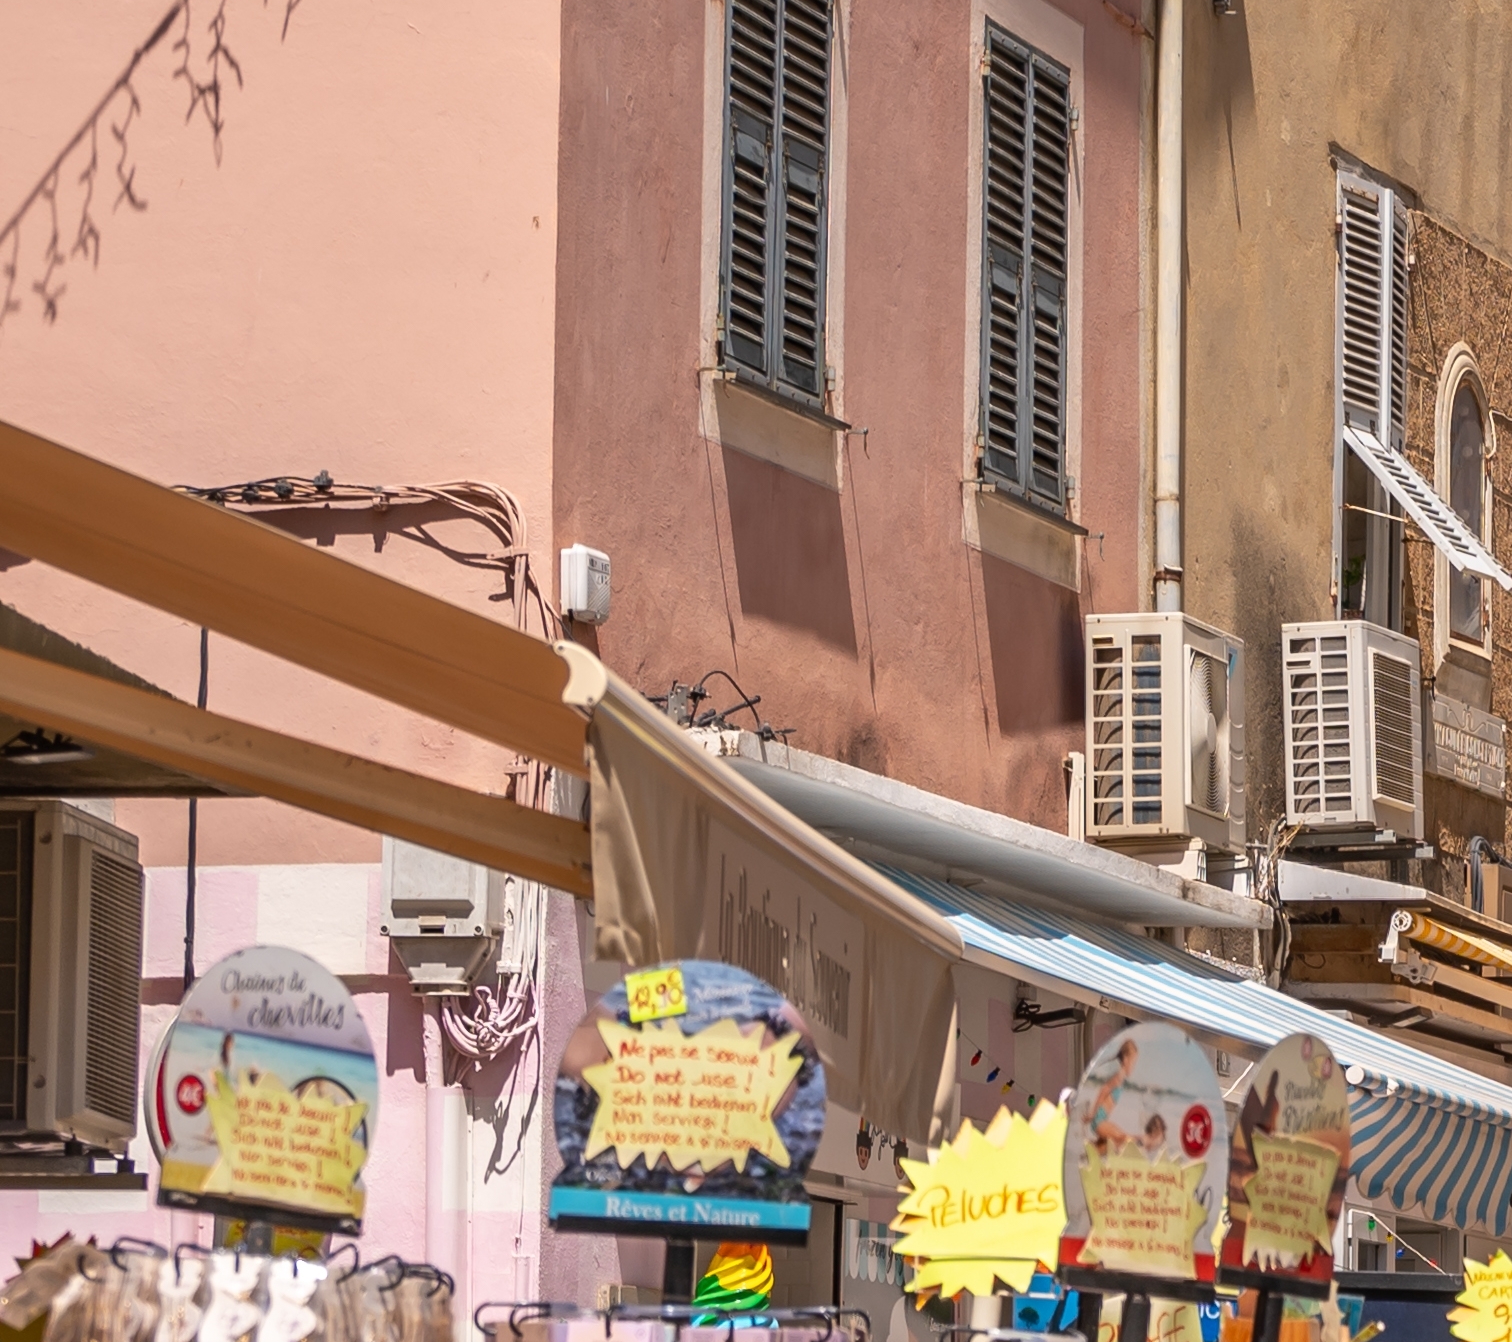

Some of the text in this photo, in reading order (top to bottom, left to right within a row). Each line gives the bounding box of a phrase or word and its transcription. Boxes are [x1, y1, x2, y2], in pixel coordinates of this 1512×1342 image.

[605, 1197, 762, 1227] Rêves et Nature
